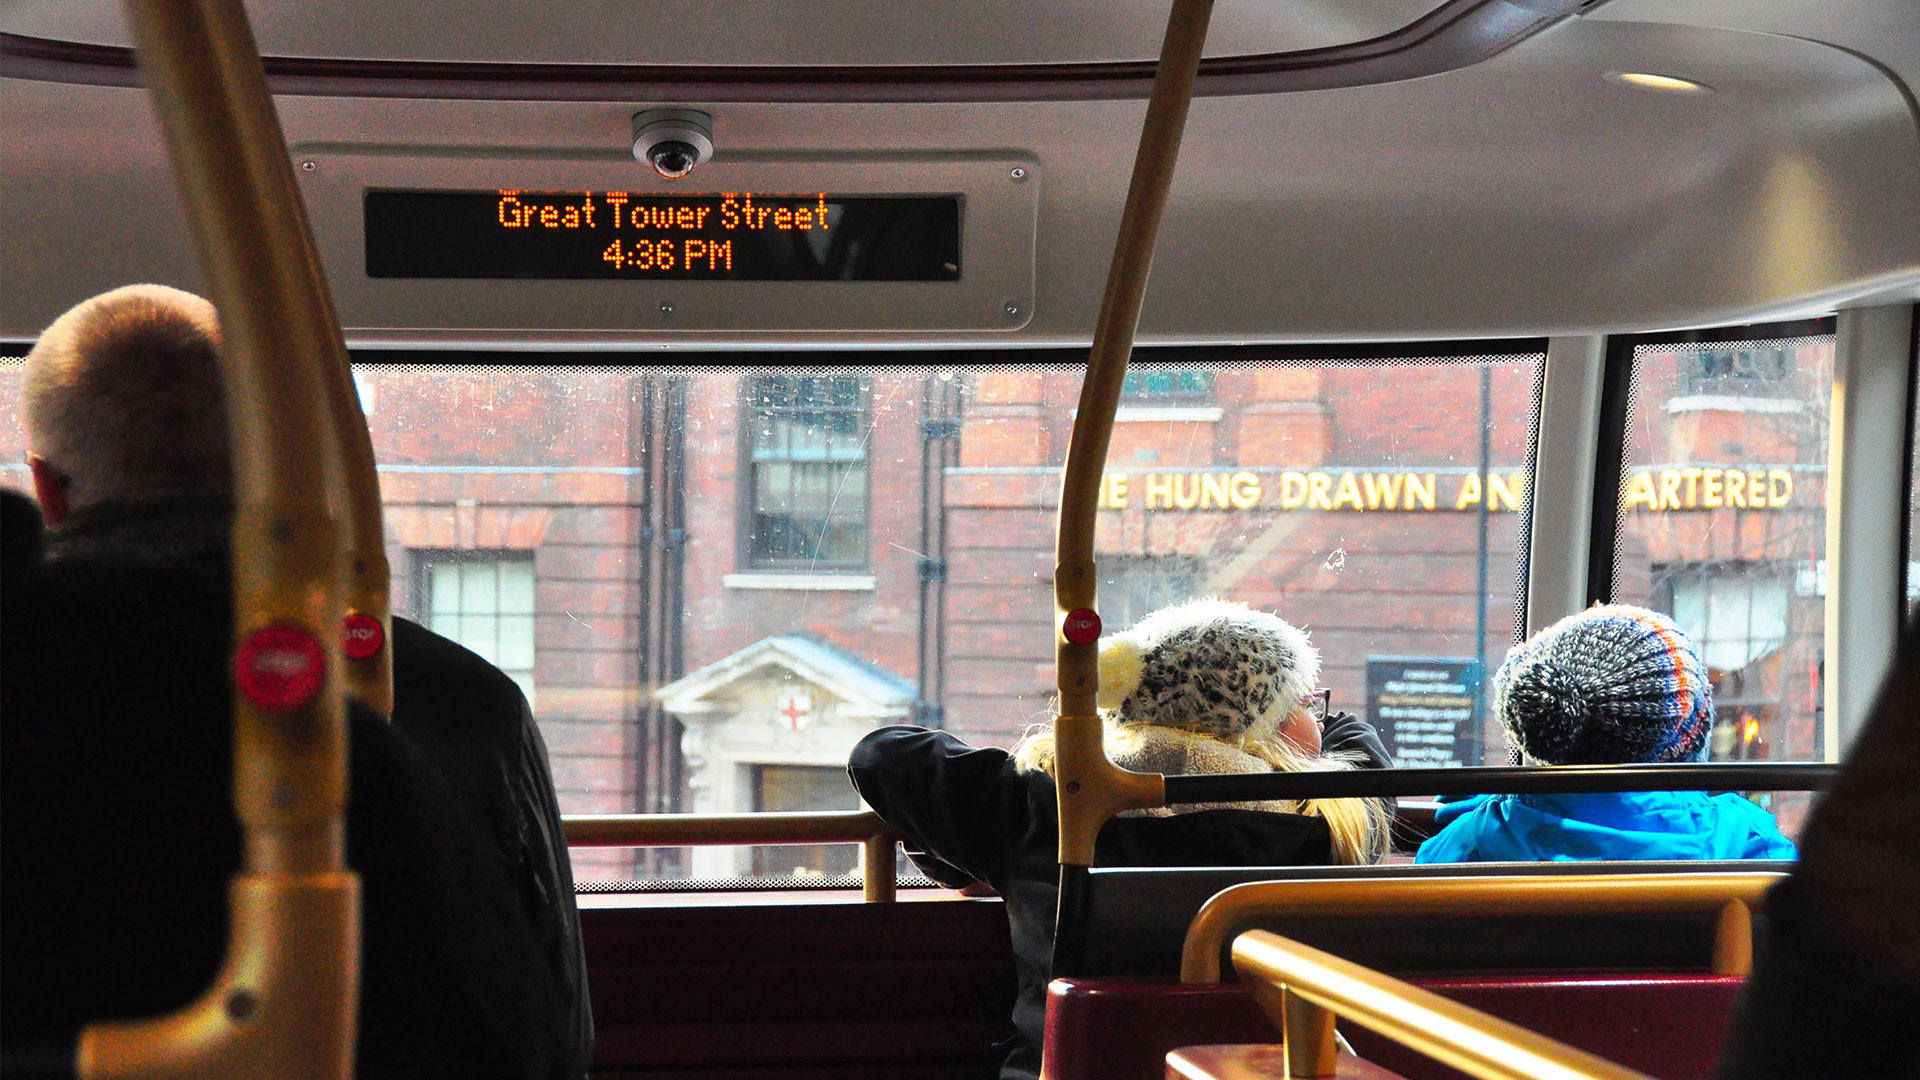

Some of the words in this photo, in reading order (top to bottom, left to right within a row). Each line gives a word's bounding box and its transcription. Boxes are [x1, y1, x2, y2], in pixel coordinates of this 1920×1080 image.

[498, 193, 597, 229] Great
[606, 195, 711, 229] Tower
[720, 193, 830, 230] Street
[602, 238, 676, 271] 4:36
[684, 238, 733, 271] PM
[1145, 472, 1262, 510] HUNG
[1280, 471, 1437, 511] DRAWN
[1456, 472, 1527, 512] AN
[1625, 467, 1794, 512] ARTERED
